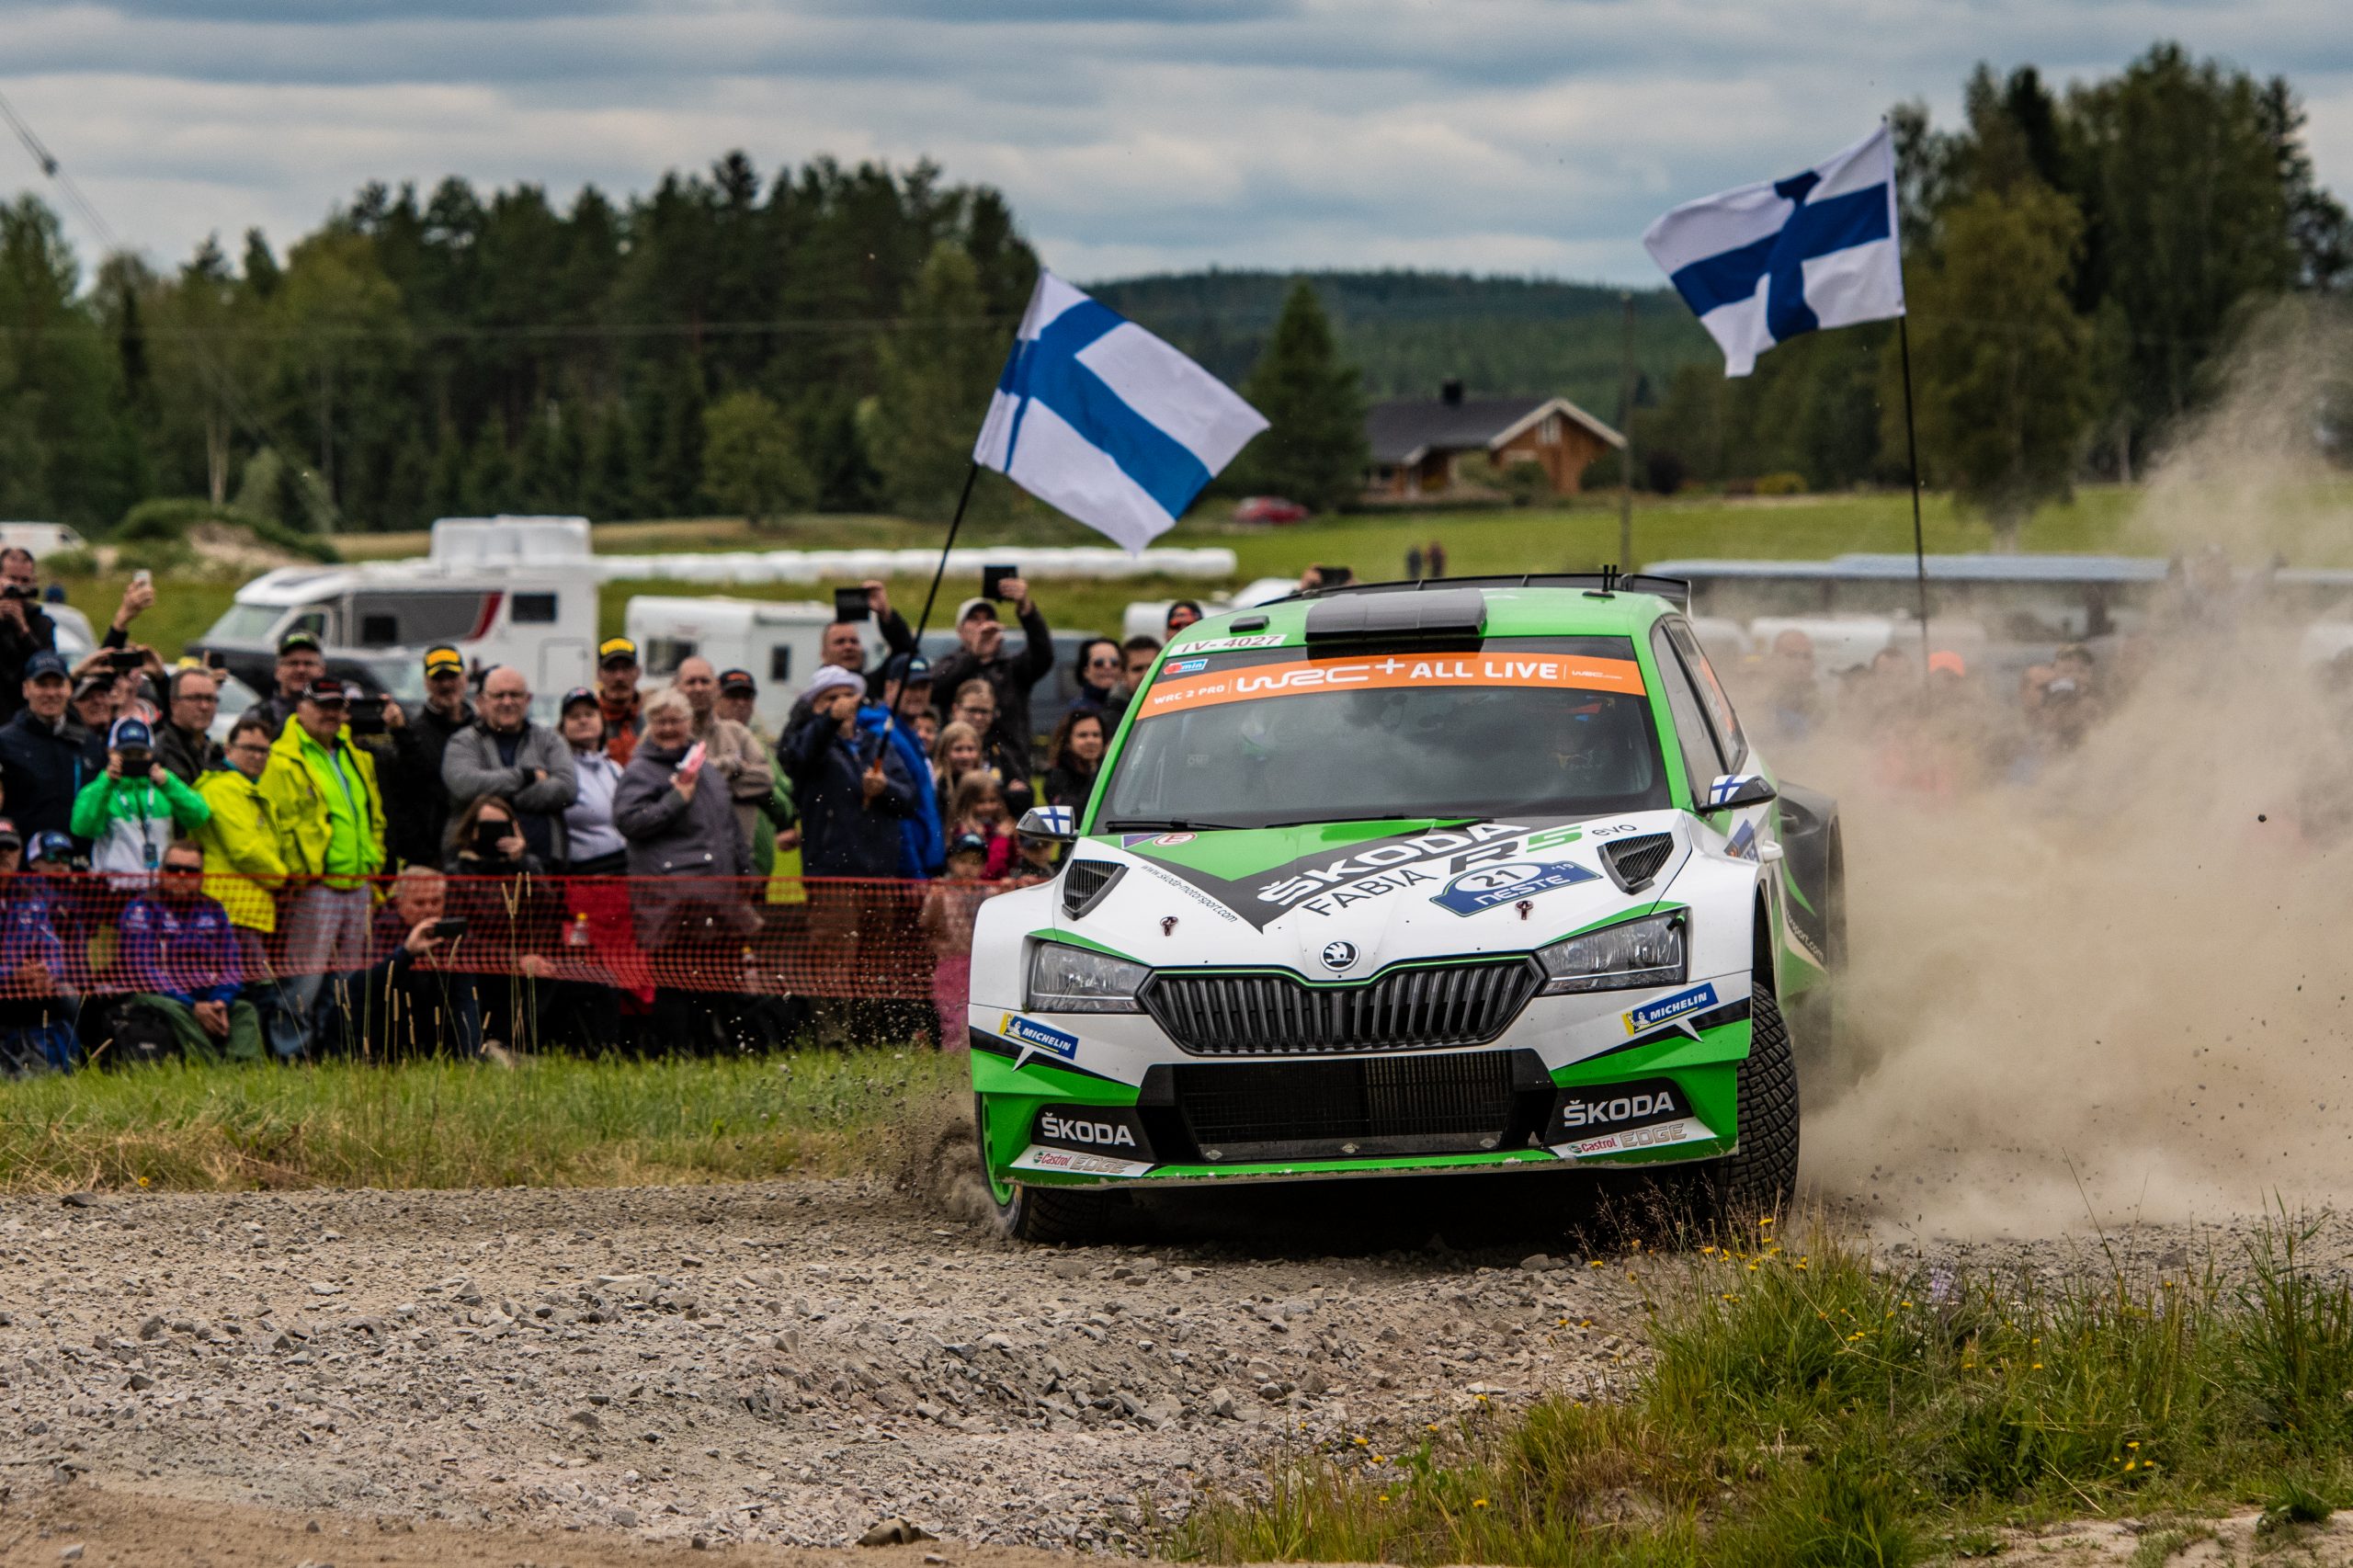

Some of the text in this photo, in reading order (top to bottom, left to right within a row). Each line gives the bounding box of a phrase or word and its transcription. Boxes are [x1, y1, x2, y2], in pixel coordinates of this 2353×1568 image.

[1154, 692, 1182, 705] WRC
[1186, 689, 1194, 698] 2
[1199, 684, 1225, 695] PRO
[1410, 662, 1473, 678] ALL
[1484, 662, 1558, 679] LIVE
[1257, 824, 1530, 905] ŠKODA
[1302, 824, 1638, 916] FABIA R5 evo
[1471, 869, 1522, 887] 21
[1473, 874, 1571, 905] NESTE
[1650, 992, 1708, 1020] MICHELIN
[1022, 1028, 1072, 1051] MICHELIN
[1563, 1091, 1675, 1127] ŠKODA
[1041, 1112, 1136, 1146] ŠKODA
[1581, 1123, 1688, 1153] Castrol EDGE
[1041, 1153, 1134, 1175] Castrol EDGE
